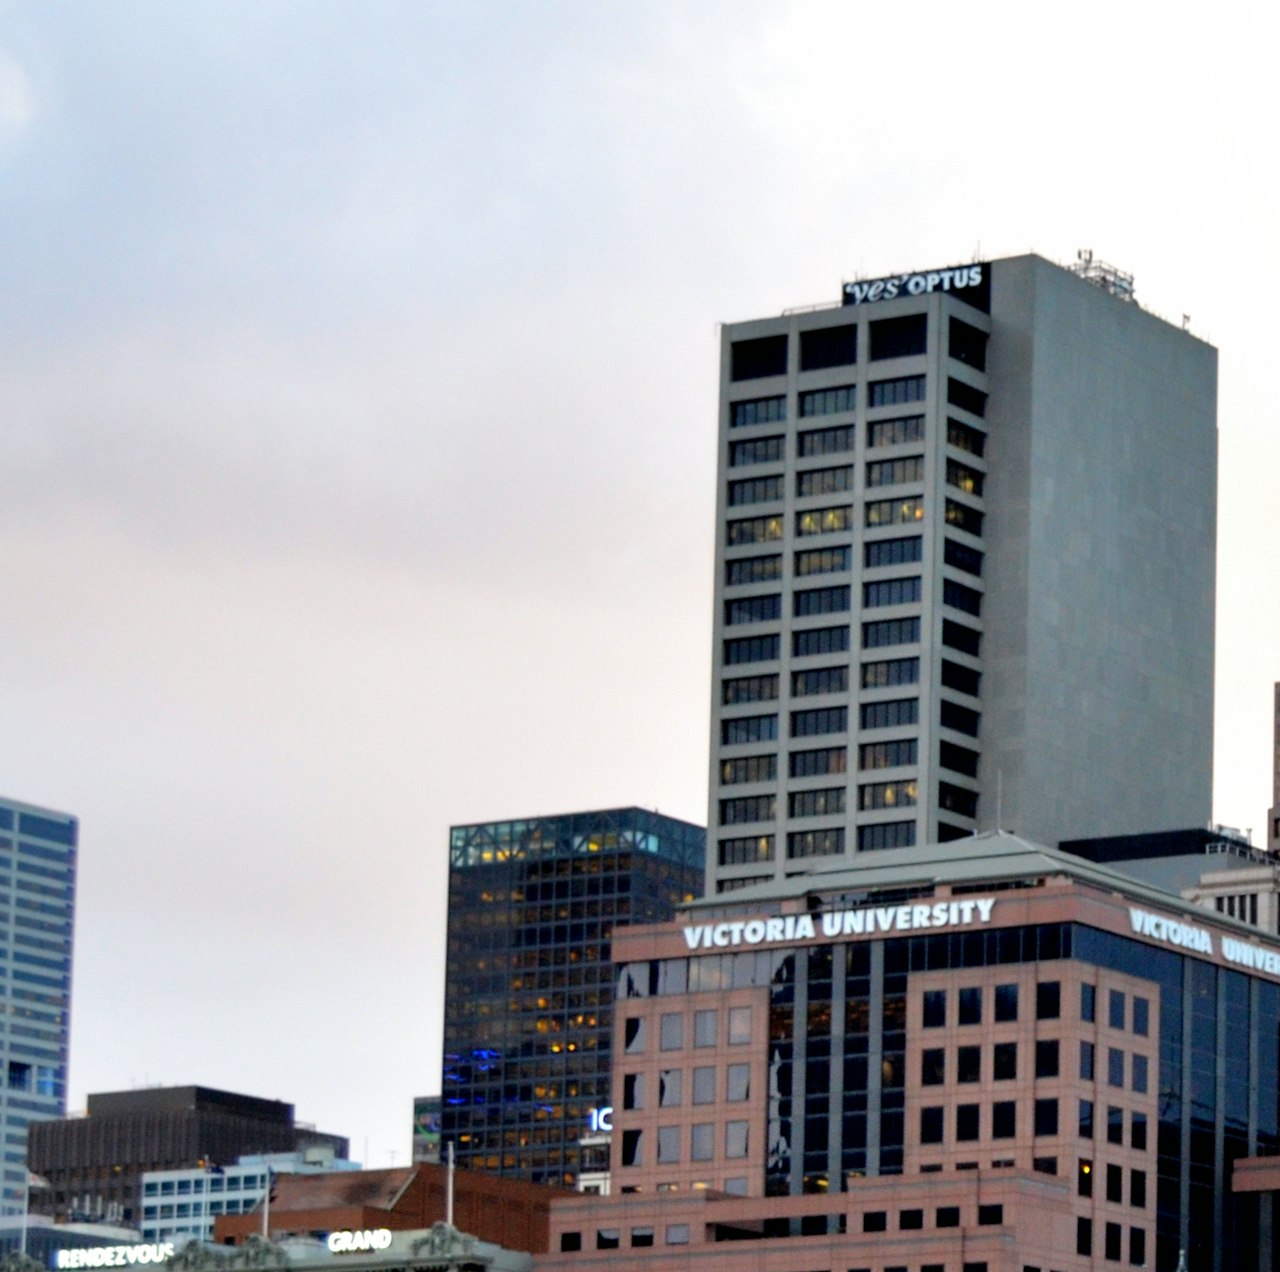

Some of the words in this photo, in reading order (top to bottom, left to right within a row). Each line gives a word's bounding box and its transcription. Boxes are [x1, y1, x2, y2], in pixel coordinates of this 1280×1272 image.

[907, 265, 982, 295] OPTUS
[684, 915, 816, 949] VICTORIA
[822, 898, 997, 936] UNIVERSITY
[1128, 908, 1212, 955] VICTORIA
[56, 1242, 175, 1269] RENDEZVOUS
[327, 1228, 393, 1253] GRAND
